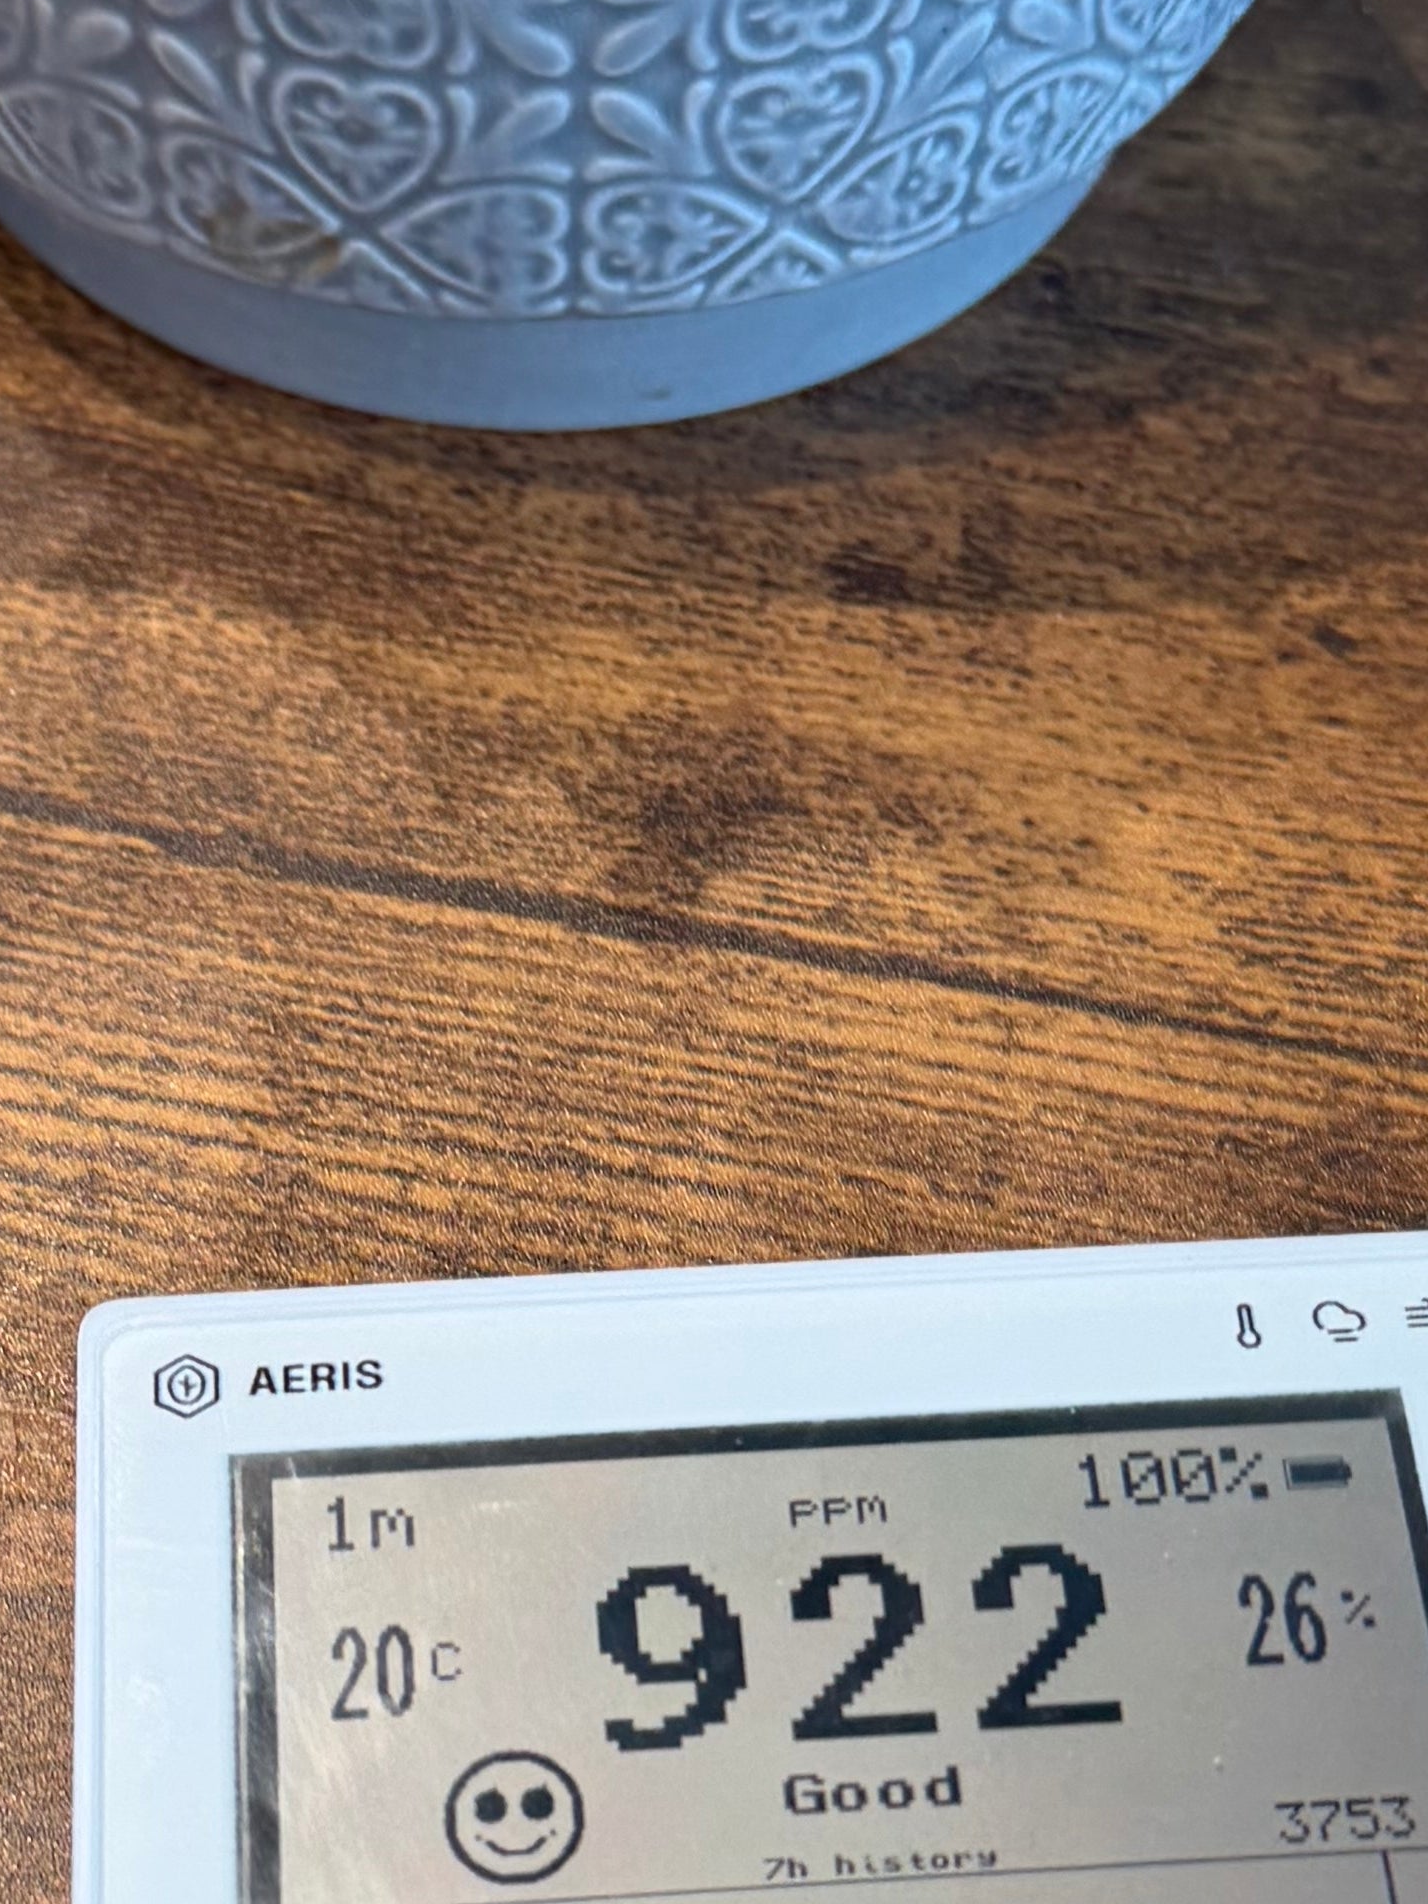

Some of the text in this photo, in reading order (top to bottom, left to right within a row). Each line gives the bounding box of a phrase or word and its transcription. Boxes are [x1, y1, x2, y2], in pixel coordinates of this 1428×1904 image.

[248, 1358, 385, 1397] AERIS
[1078, 1446, 1270, 1510] 100%
[326, 1495, 416, 1553] 1m
[787, 1494, 890, 1529] PPM
[595, 1542, 1124, 1753] 922
[782, 1764, 964, 1816] Good
[1273, 1795, 1416, 1844] 3753
[763, 1848, 999, 1882] 7h history
